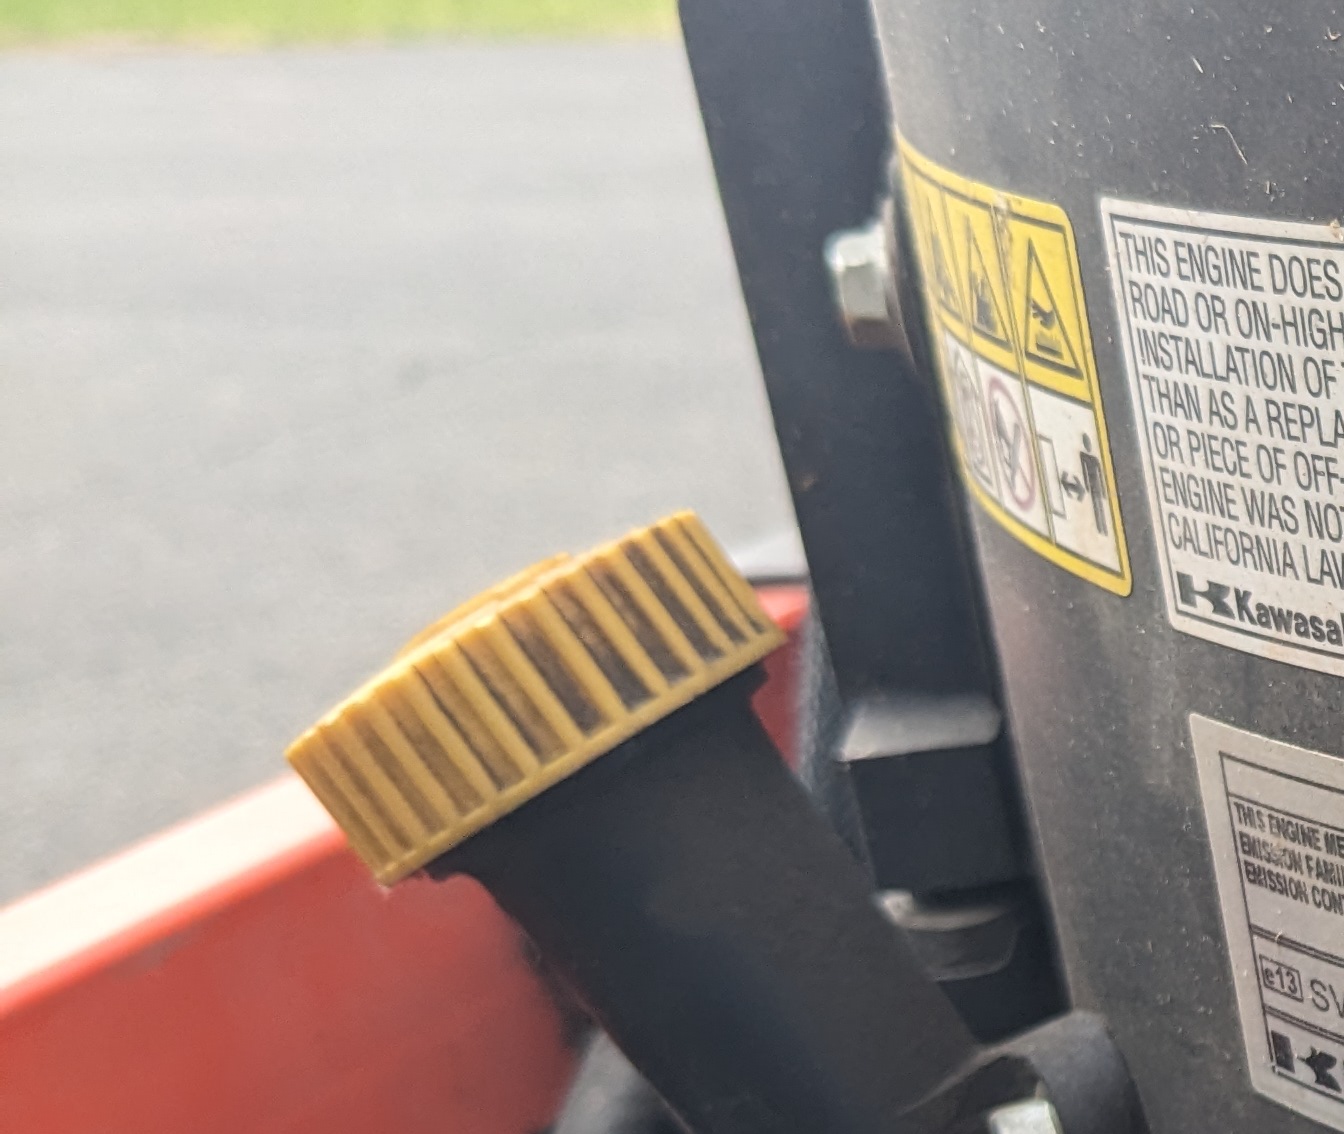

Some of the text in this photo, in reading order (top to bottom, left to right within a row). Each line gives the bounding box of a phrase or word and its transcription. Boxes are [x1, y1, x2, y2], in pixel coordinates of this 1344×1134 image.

[1119, 232, 1171, 277] THIS
[1175, 242, 1264, 292] ENGINE
[1269, 253, 1342, 300] DOES
[1129, 280, 1187, 327] ROAD
[1198, 292, 1230, 335] OR
[1137, 327, 1297, 393] INSTALLATION
[1304, 355, 1336, 397] OF
[1142, 374, 1200, 420] THAN
[1207, 387, 1238, 428] AS
[1245, 395, 1261, 436] A
[1155, 427, 1182, 465] OR
[1189, 434, 1252, 478] PIECE
[1258, 445, 1287, 485] OF
[1159, 466, 1240, 522] ENGINE
[1242, 487, 1299, 534] WAS
[1166, 511, 1302, 578] CALIFORNIA
[1234, 802, 1265, 832] THIS
[1268, 813, 1321, 851] ENGINE
[1239, 830, 1303, 875] EMISSION
[1243, 859, 1310, 905] EMISSION
[1263, 966, 1298, 994] e13
